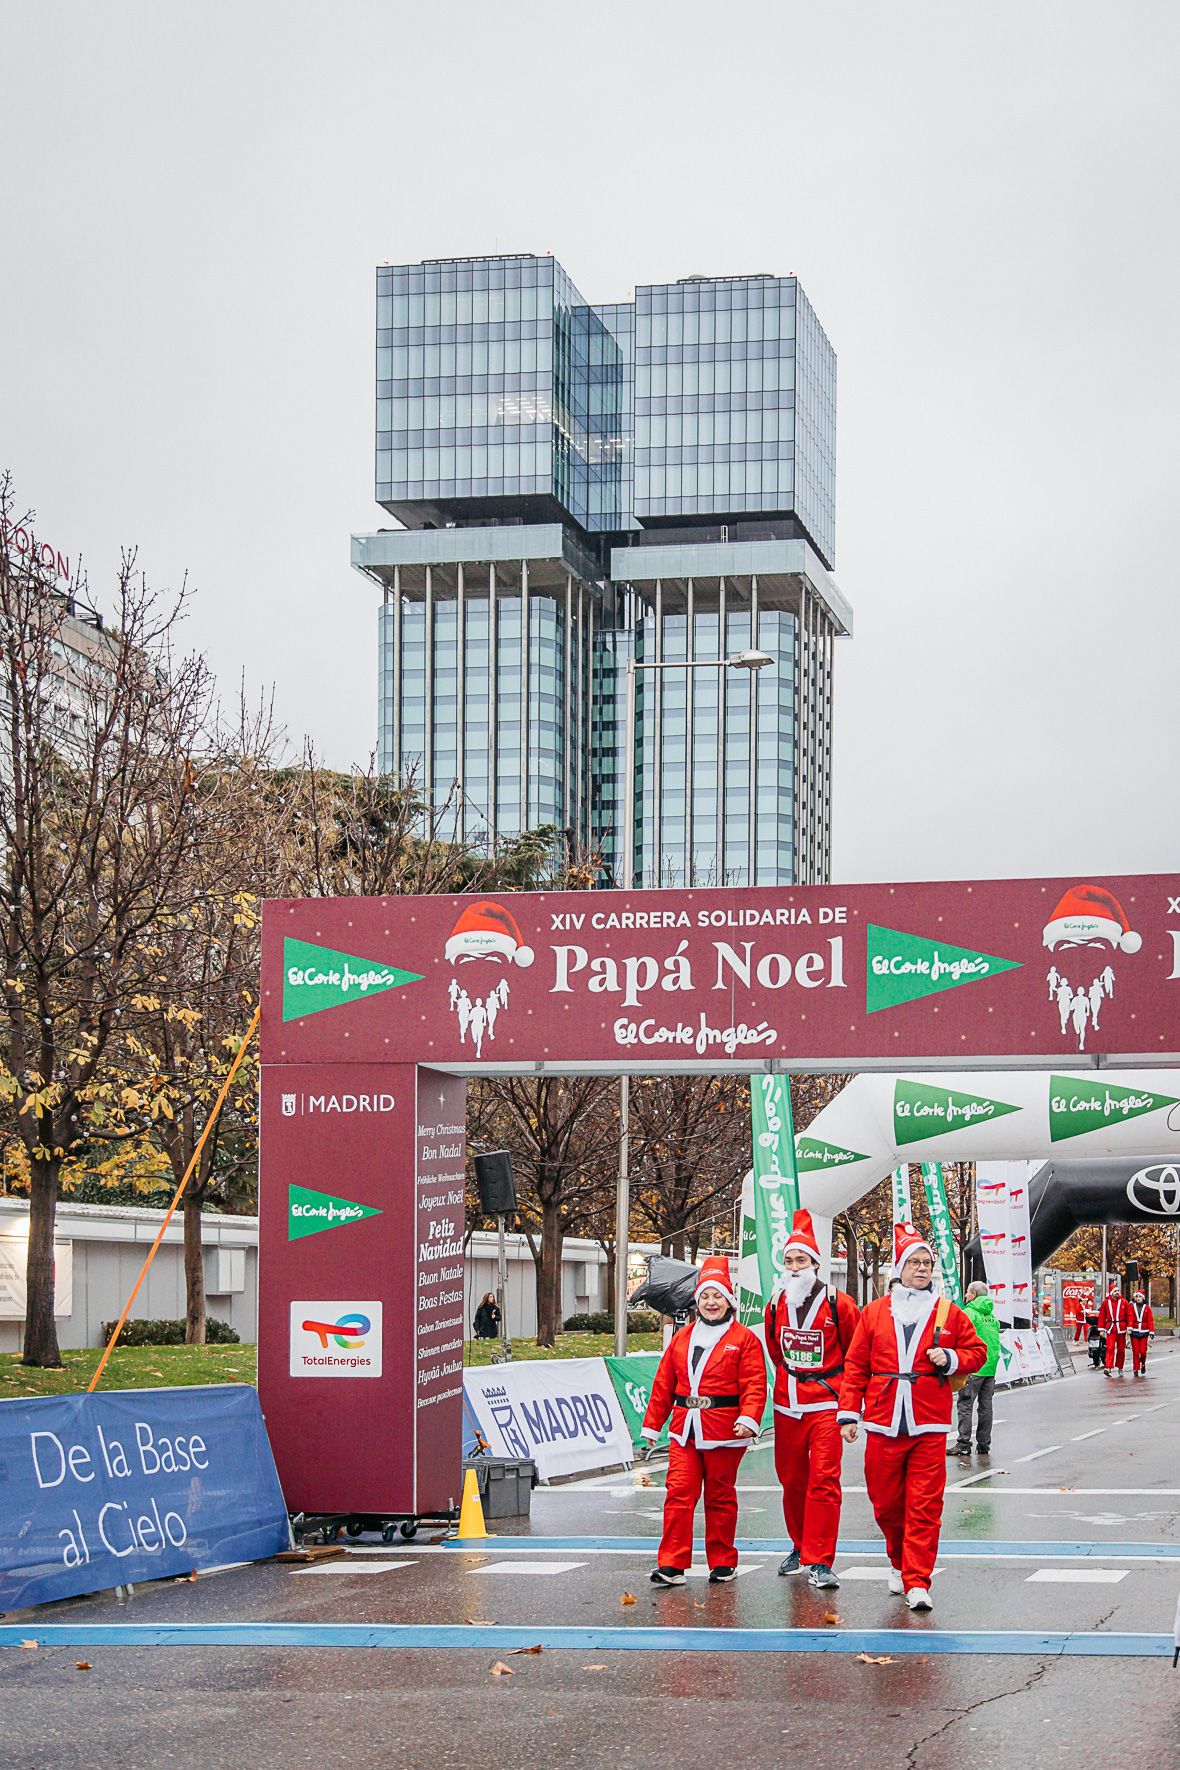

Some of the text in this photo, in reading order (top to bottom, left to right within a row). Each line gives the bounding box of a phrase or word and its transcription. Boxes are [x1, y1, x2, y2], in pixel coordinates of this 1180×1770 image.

[550, 907, 848, 930] XIV CARRERA SOLIDARIA DE
[548, 936, 848, 1007] Papá Noel
[872, 950, 990, 981] El Corte Inglés
[287, 963, 395, 992] El Corte Inglés
[613, 1012, 778, 1055] El Corte Inglés
[309, 1094, 395, 1113] MADRID
[896, 1096, 995, 1122] El Corte Inglés
[1052, 1090, 1153, 1116] El Corte Inglés
[418, 1123, 466, 1139] Merry Christmas
[422, 1143, 461, 1160] Bon Nadal
[804, 1149, 822, 1159] Corte
[292, 1201, 364, 1221] El Corte Inglés
[419, 1189, 464, 1211] Joyeux Noël
[428, 1218, 455, 1240] Feliz
[418, 1235, 464, 1262] Navidad
[418, 1264, 463, 1287] Buon Natale
[418, 1290, 462, 1311] Boas Festas
[302, 1356, 371, 1367] TotalEnergies
[520, 1393, 613, 1445] MADRID
[30, 1422, 209, 1489] De la Base
[58, 1498, 187, 1568] al Cielo
